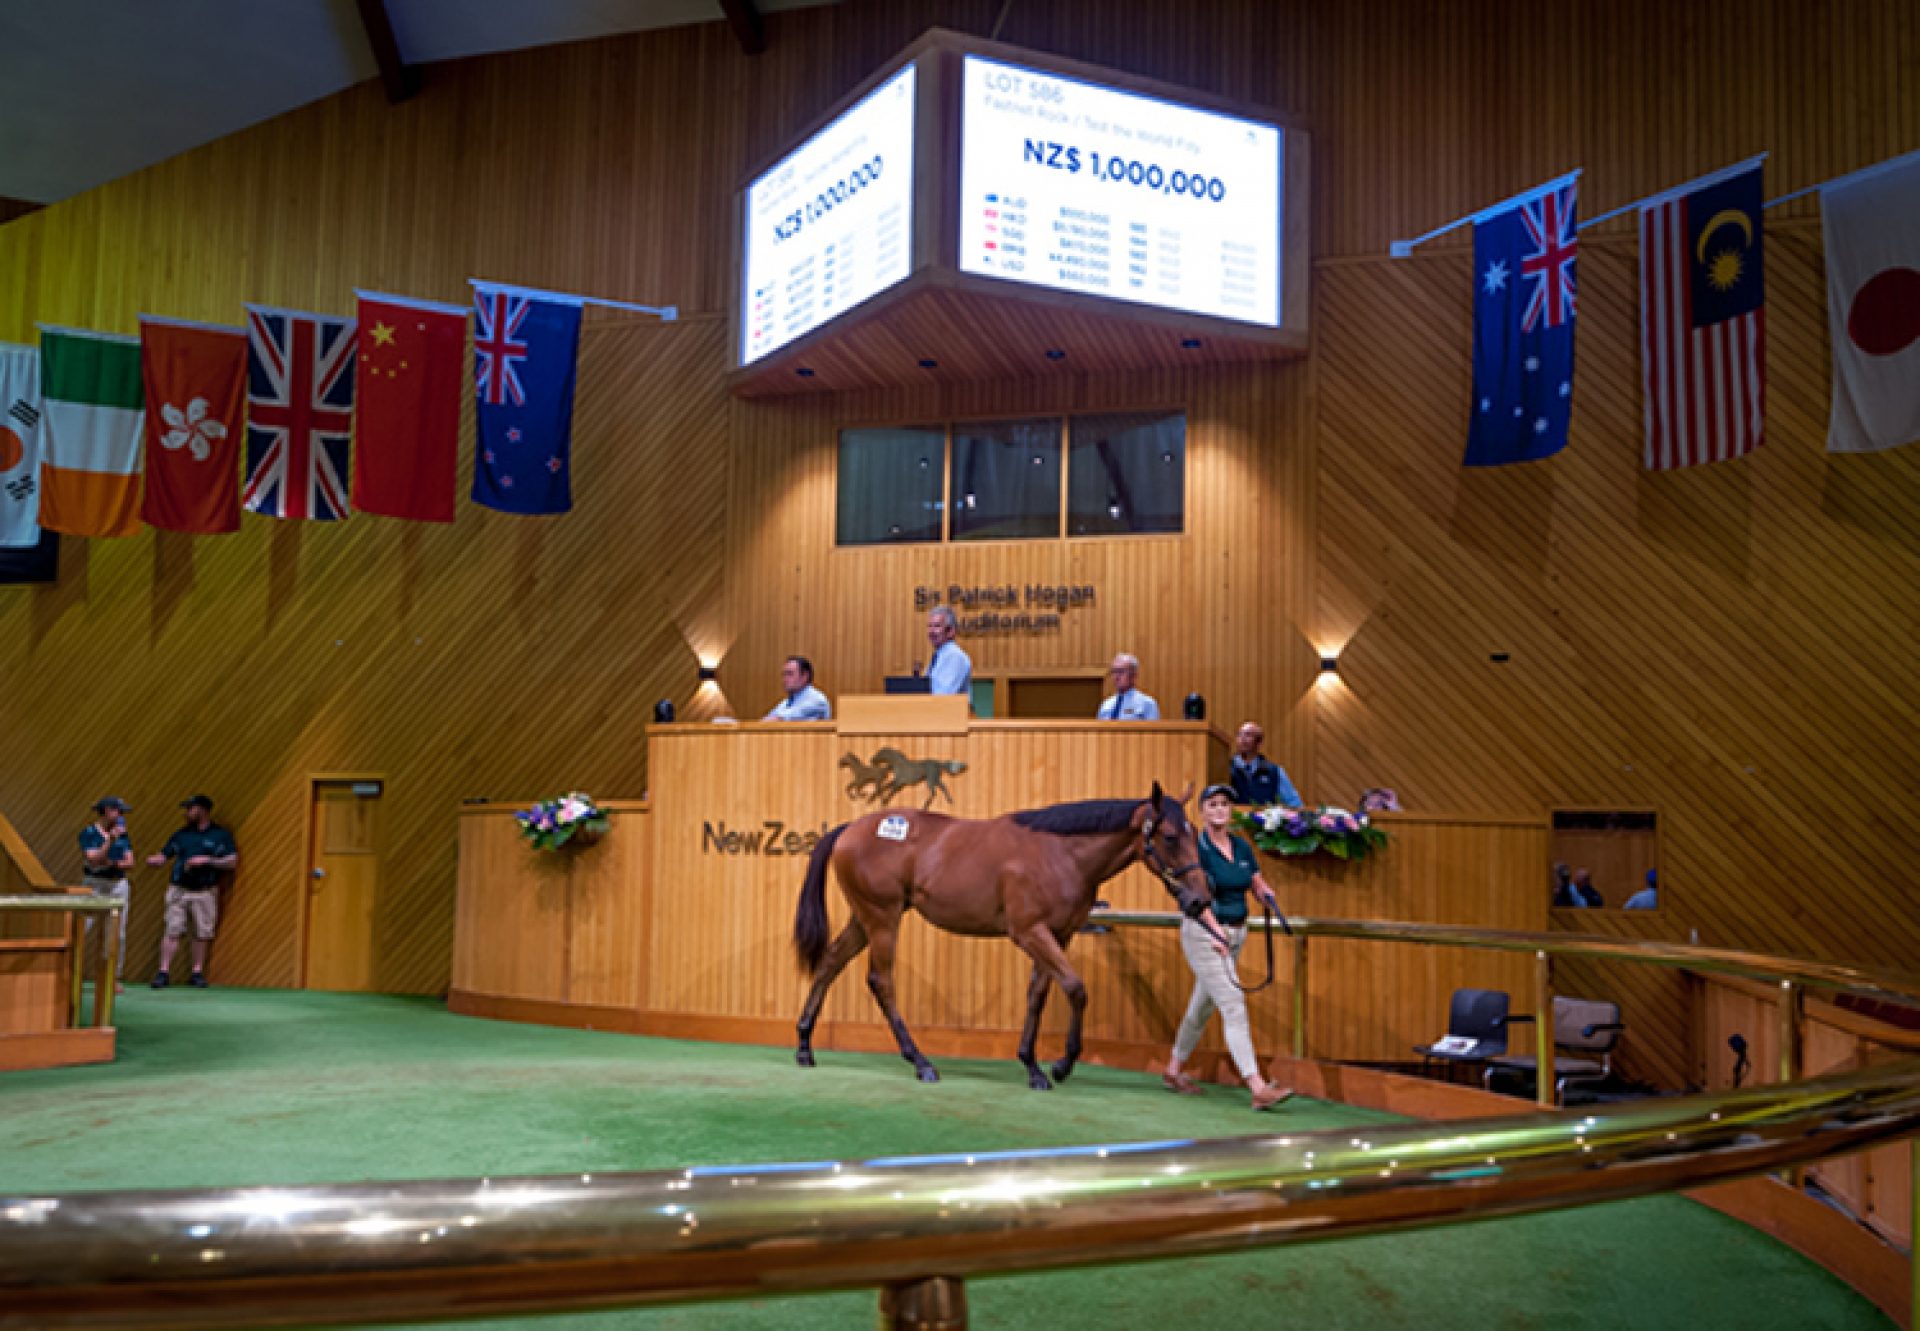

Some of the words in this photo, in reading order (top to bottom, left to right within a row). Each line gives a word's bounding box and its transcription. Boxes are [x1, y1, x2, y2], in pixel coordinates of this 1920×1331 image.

[984, 71, 1024, 93] LOT
[1023, 137, 1081, 173] NZ$
[1090, 152, 1226, 203] 1,000,000
[914, 585, 941, 606] Sir
[947, 584, 1018, 606] Patrick
[1024, 584, 1095, 612] Hogan
[956, 612, 1060, 633] uditorium
